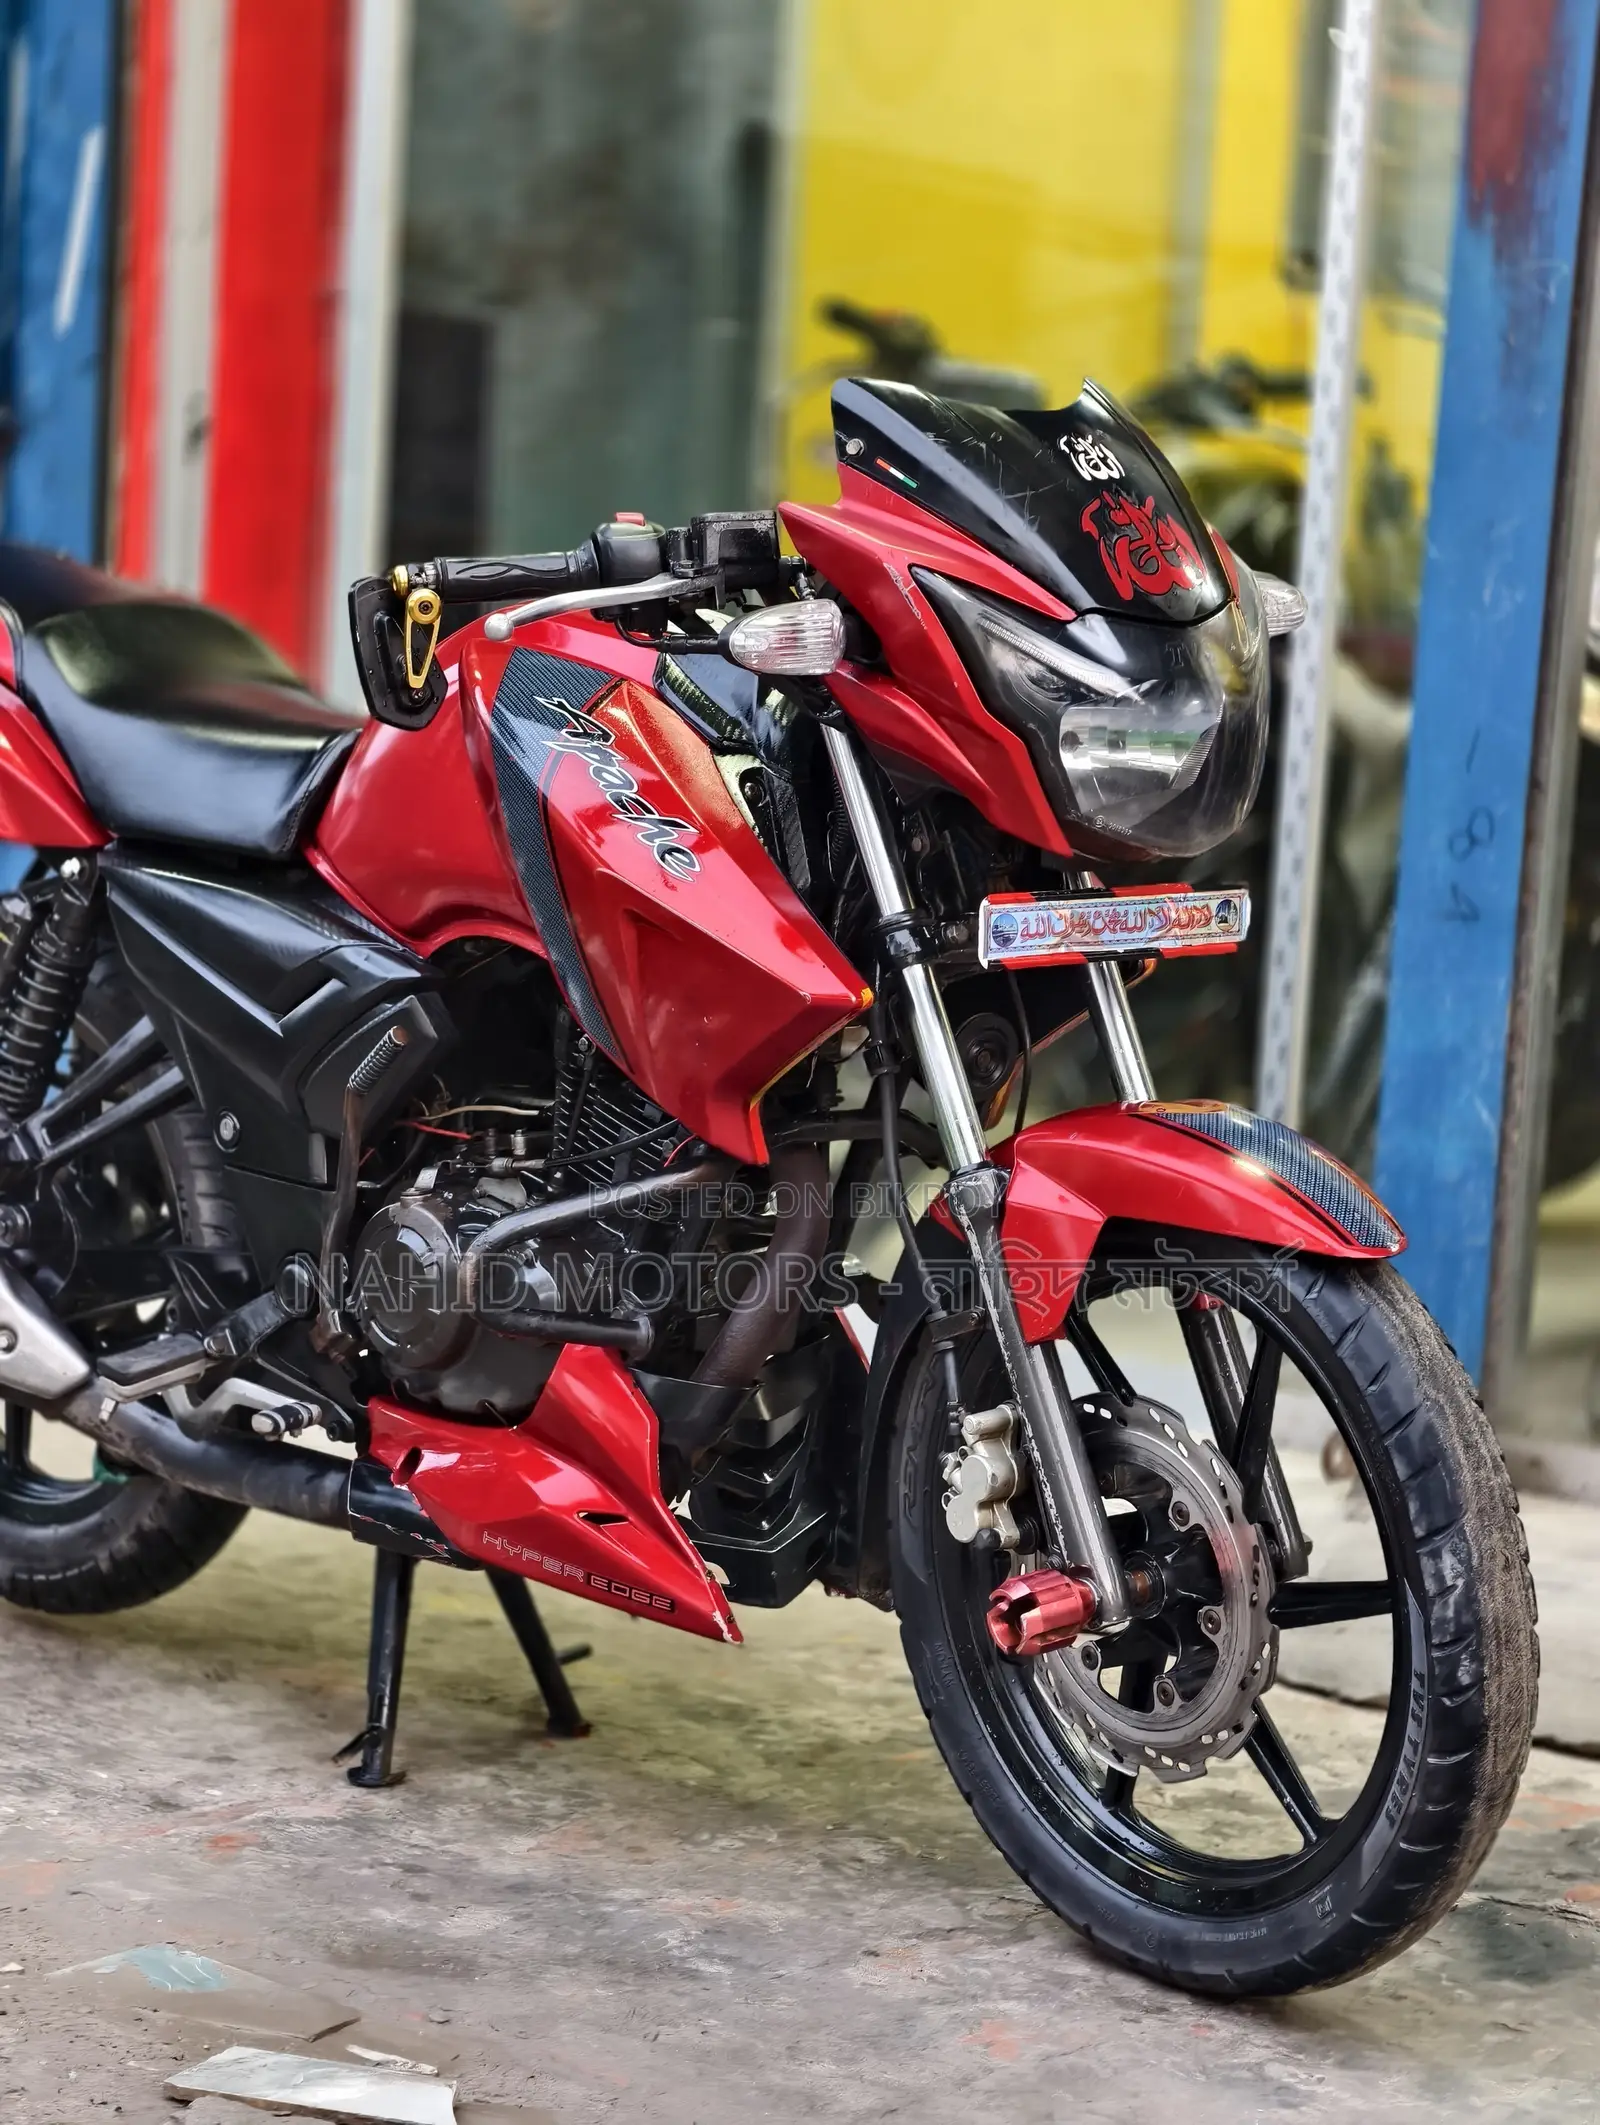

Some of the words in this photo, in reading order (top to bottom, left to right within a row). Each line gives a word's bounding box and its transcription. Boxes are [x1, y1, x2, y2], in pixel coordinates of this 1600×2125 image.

[533, 696, 702, 882] Apache
[482, 1531, 585, 1582] HYPER
[590, 1576, 672, 1611] EDGE
